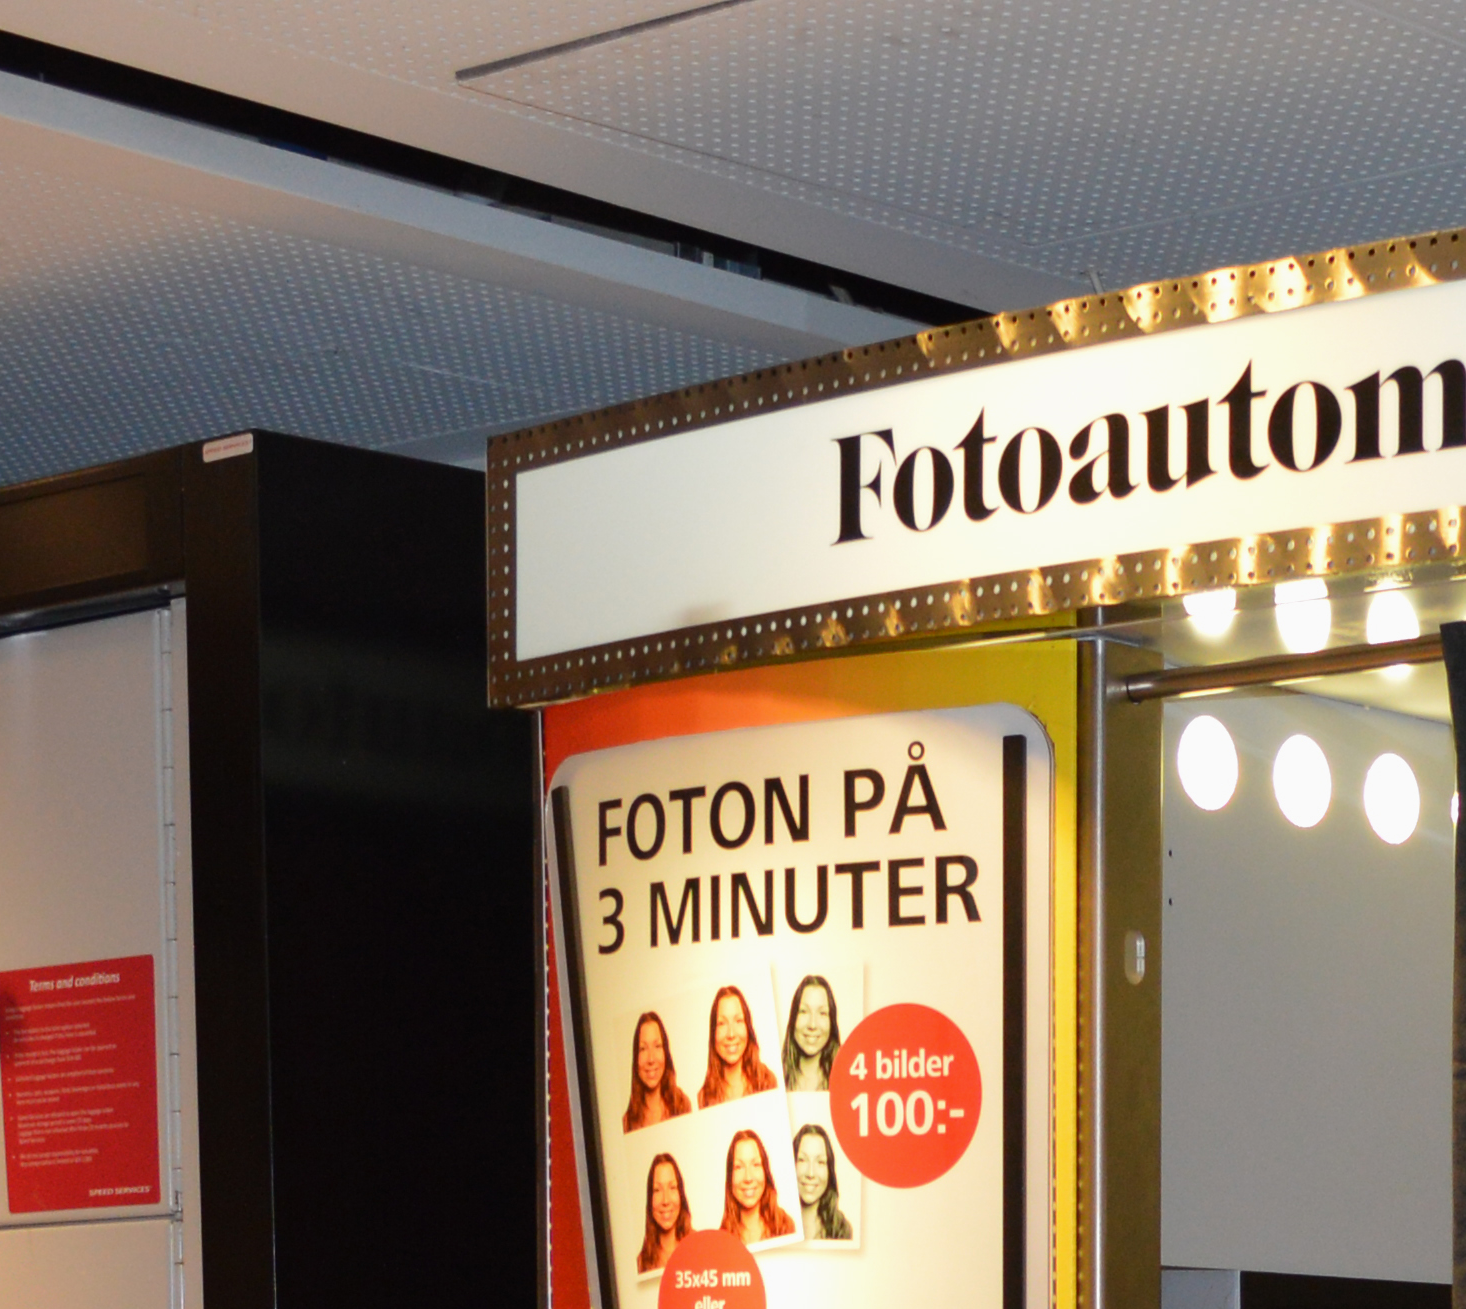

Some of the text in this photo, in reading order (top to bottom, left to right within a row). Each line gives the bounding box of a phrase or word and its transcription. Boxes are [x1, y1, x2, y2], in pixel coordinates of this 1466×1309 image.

[597, 740, 948, 867] FOTON PÅ
[597, 854, 983, 955] 3 MINUTER
[29, 971, 121, 993] Terms and conditions
[849, 1048, 955, 1081] 4 bilder
[849, 1089, 966, 1138] 100:-
[674, 1270, 751, 1290] 35x45 mm
